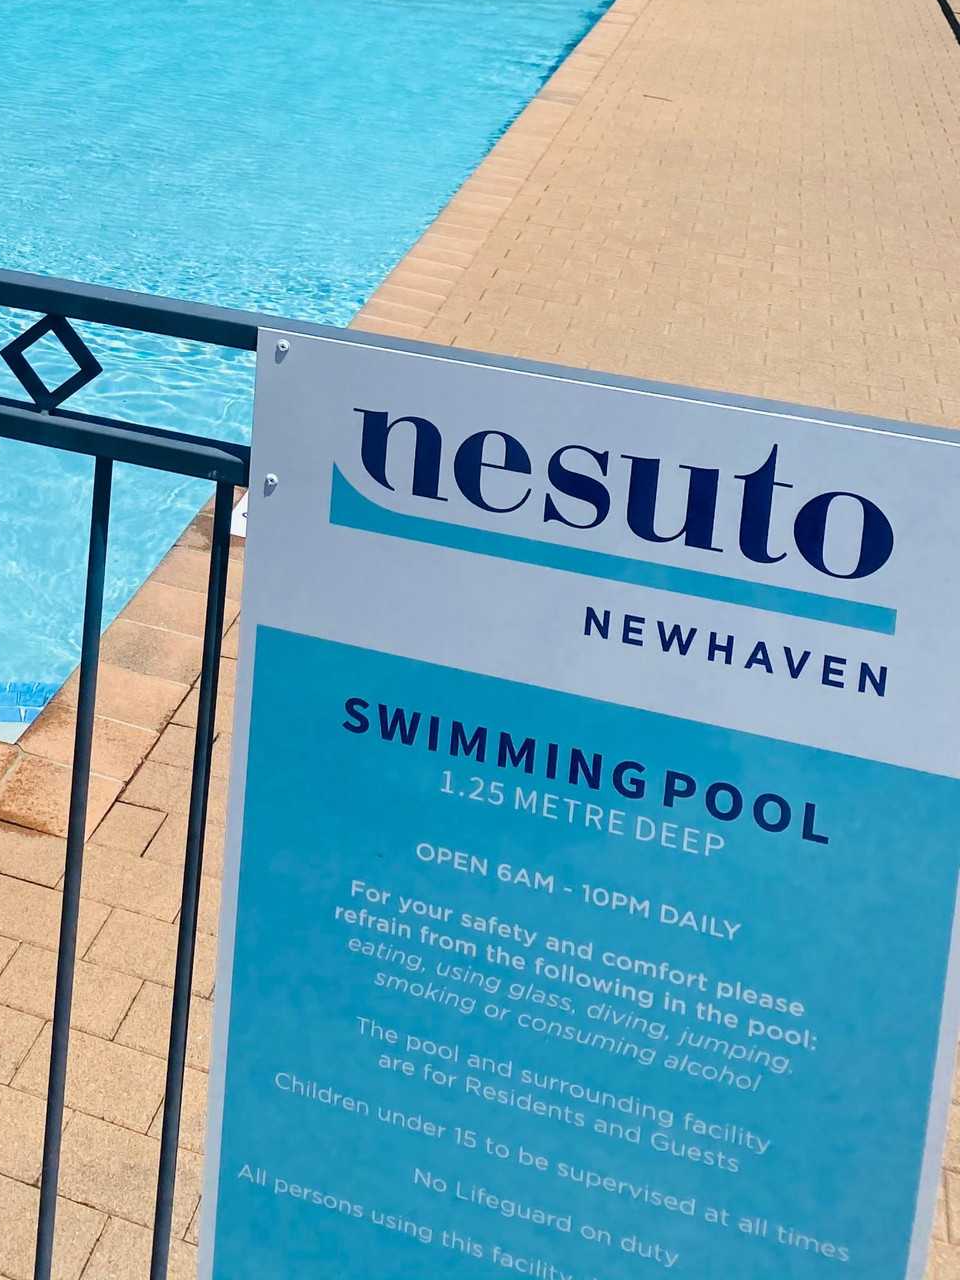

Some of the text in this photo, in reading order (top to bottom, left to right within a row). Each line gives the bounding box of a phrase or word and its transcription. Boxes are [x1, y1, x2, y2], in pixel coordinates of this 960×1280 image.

[354, 408, 893, 579] nesuto
[584, 607, 887, 696] NEWHAVEN
[343, 698, 828, 844] SWIMMING POOL
[440, 770, 725, 856] 1.25 METRE DEEP
[351, 880, 804, 1016] For your safety and comfort please
[416, 843, 488, 876] OPEN
[497, 863, 554, 893] 6AM
[582, 884, 650, 918] 10PM
[660, 904, 741, 940] DAILY
[335, 906, 817, 1050] refrain from the following in the pool:
[348, 939, 792, 1074] eating, using glass, diving, jumping,
[374, 973, 761, 1091] smoking or consuming alcohol
[357, 1017, 770, 1154] The pool and surrounding facility
[379, 1055, 738, 1172] are for Residents and Guests
[238, 1164, 266, 1186] All
[275, 1178, 363, 1217] persons
[372, 1210, 432, 1243] using
[441, 1231, 483, 1258] this
[275, 1073, 848, 1261] Children under 15 to be supervised at all times
[414, 1168, 678, 1267] No Lifeguard on duty
